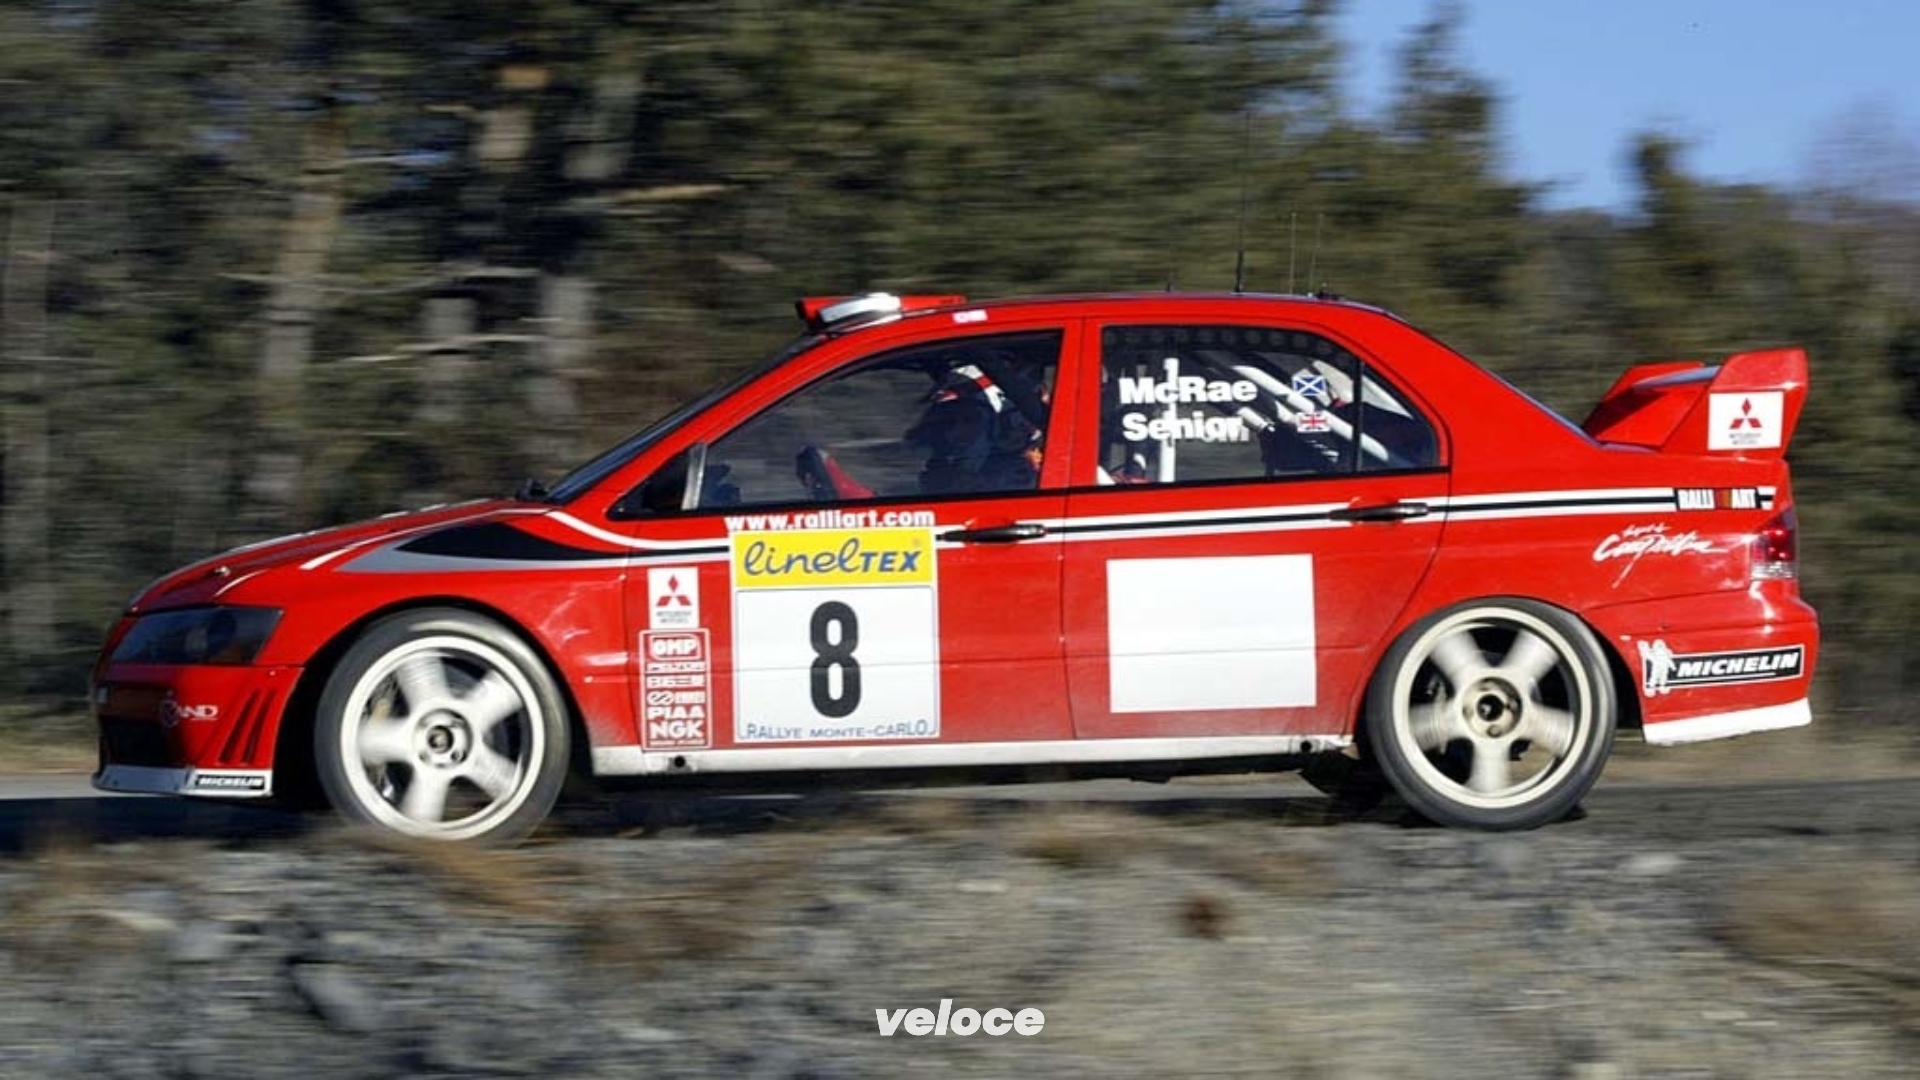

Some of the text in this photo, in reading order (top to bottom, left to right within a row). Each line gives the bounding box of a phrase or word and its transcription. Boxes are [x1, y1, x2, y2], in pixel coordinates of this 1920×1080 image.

[1119, 376, 1258, 404] McRae
[724, 509, 936, 531] www.ralliart.com
[810, 600, 862, 719] 8
[1677, 651, 1799, 678] MICHELIN
[646, 706, 706, 721] PIAA
[650, 720, 704, 740] NGK
[747, 719, 928, 739] RALLYE MONTE-CARLO
